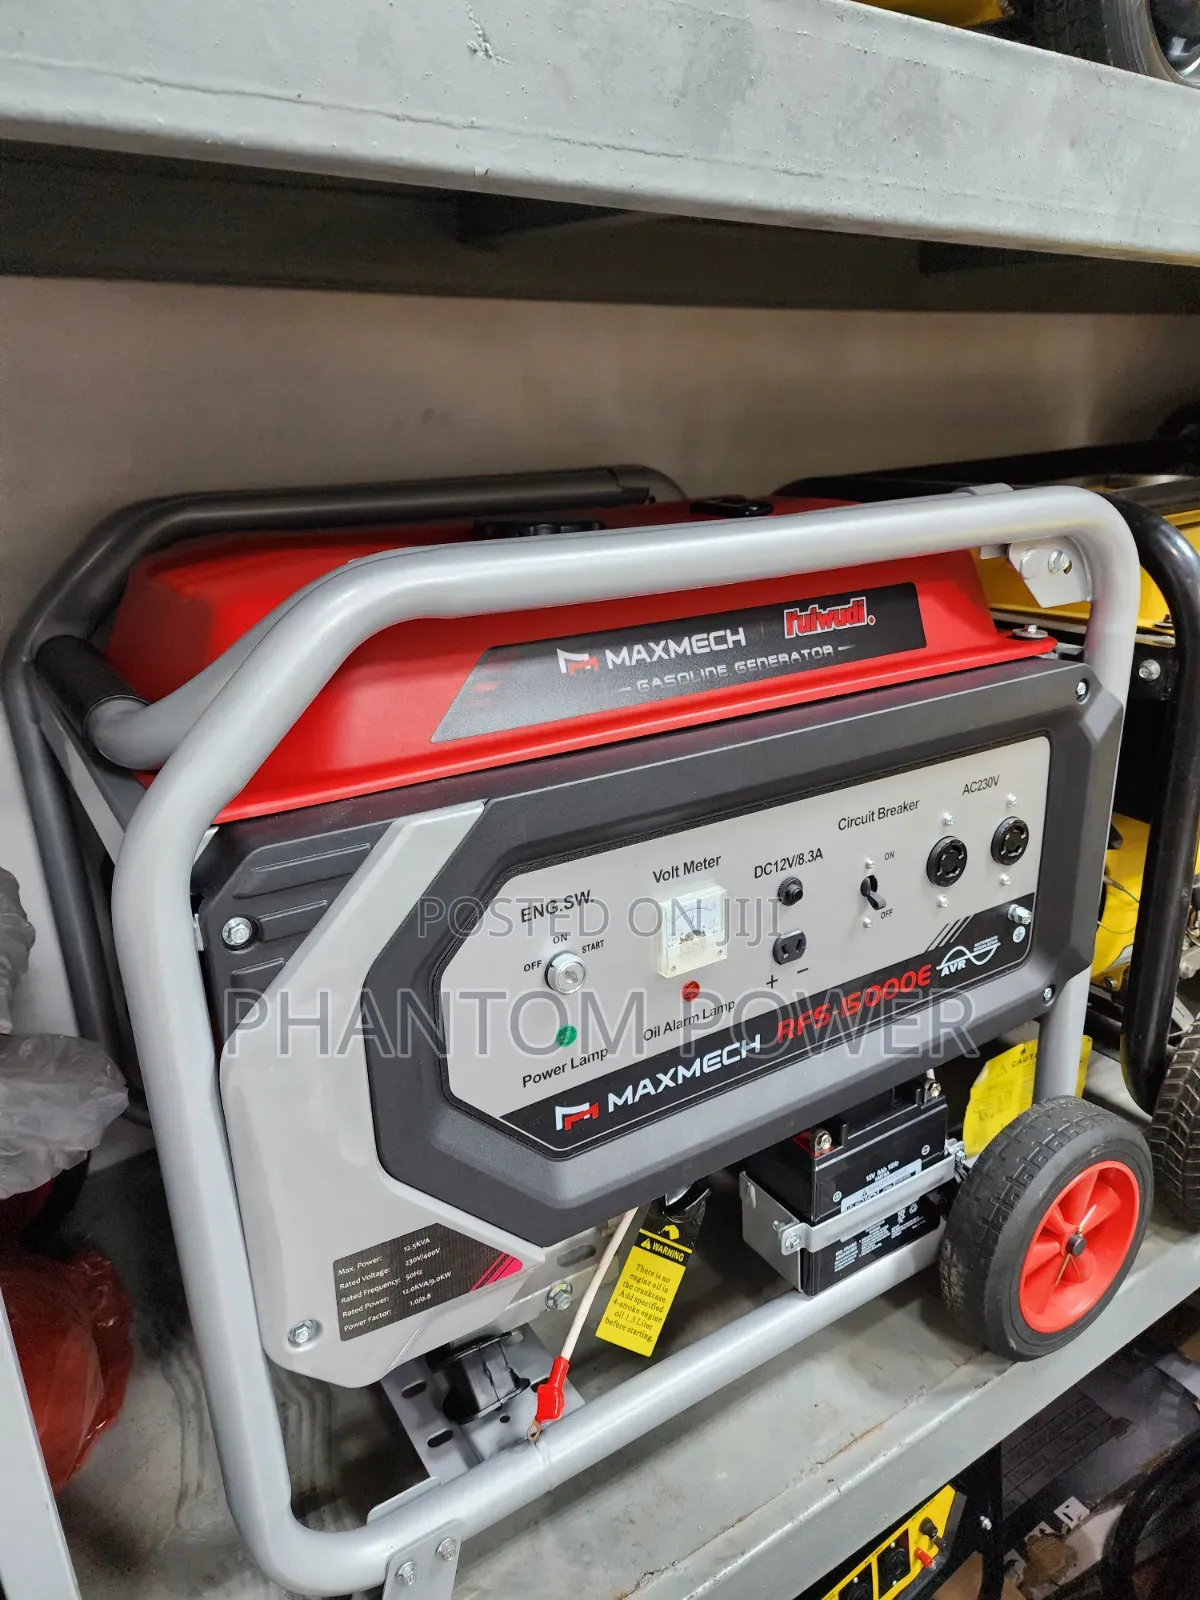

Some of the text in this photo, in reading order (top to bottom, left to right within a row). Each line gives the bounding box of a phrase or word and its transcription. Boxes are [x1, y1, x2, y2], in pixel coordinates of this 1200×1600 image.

[605, 627, 747, 670] MAXMECH
[636, 645, 834, 692] GASOLINE GENERATOR
[962, 774, 1000, 796] AC230V
[838, 800, 920, 831] Circuit Breaker
[653, 855, 722, 884] Volt Meter
[754, 847, 823, 879] DC12V/8.3A
[884, 851, 895, 861] ON
[520, 889, 594, 923] ENG.SW.
[880, 909, 893, 920] OFF
[552, 933, 568, 944] ON
[582, 940, 605, 954] START
[523, 960, 543, 973] OFF
[940, 959, 966, 977] AVR
[643, 1000, 736, 1042] Oil Alarm Lamp
[608, 963, 932, 1113] MAXMECH RFS-15000E
[522, 1048, 609, 1089] Power Lamp
[338, 1237, 430, 1277] Max. Power: 12.5KVA
[652, 1241, 685, 1262] WARNING
[340, 1247, 441, 1290] Rated Voltage: 230V/400V
[636, 1264, 671, 1284] There is no
[341, 1269, 423, 1304] Rated Frequency: 50Hz
[342, 1270, 452, 1318] Rated Power: 12.0KVA/9.0KW
[622, 1280, 667, 1304] the crankcase.
[629, 1273, 669, 1294] engine oil in
[344, 1292, 432, 1332] Power Factor: 1.0/0.8
[613, 1298, 663, 1324] 4-stroke engine
[619, 1290, 665, 1314] Add specified
[605, 1316, 654, 1343] before starting.
[614, 1310, 625, 1319] oil
[636, 1318, 653, 1331] Liter
